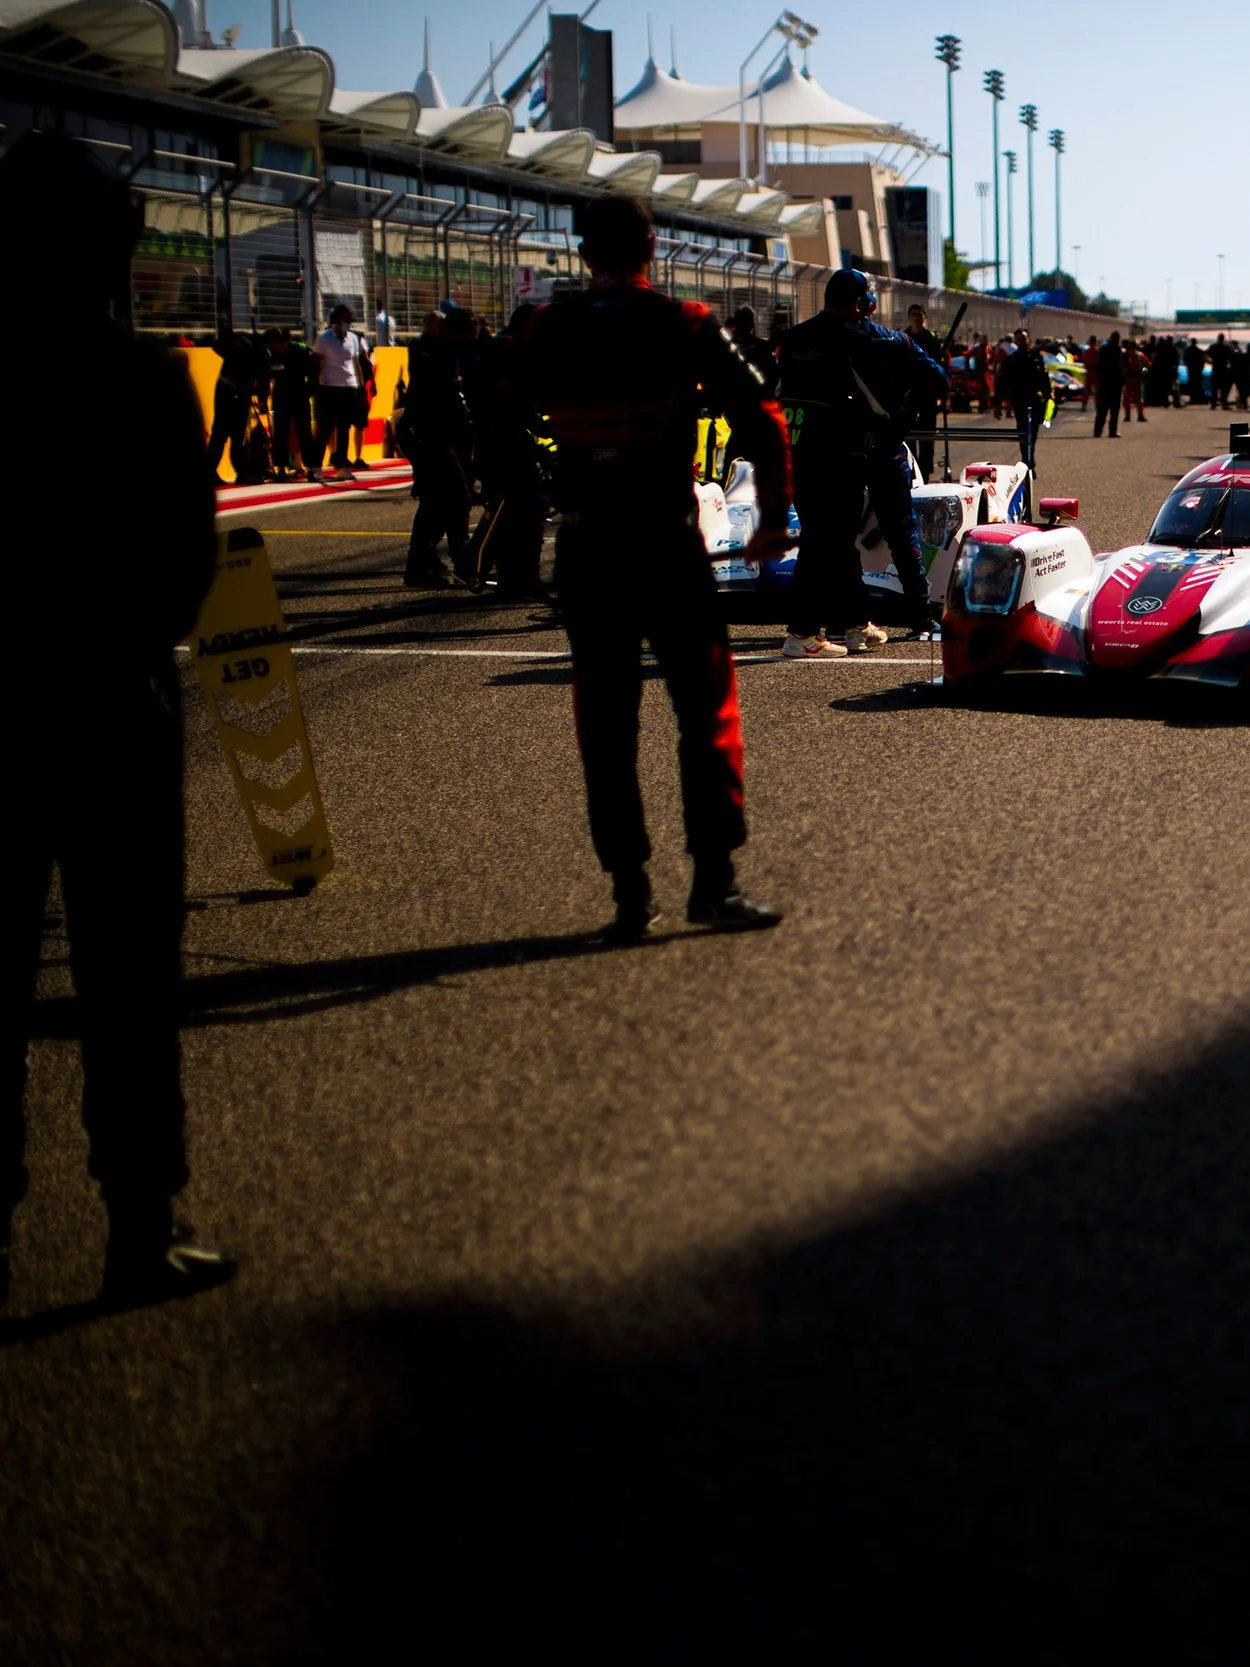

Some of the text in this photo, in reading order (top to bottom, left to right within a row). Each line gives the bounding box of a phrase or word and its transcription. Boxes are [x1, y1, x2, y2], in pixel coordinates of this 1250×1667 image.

[1035, 549, 1065, 567] Drive Fast
[1035, 560, 1067, 578] Act Faster
[221, 657, 270, 683] GET
